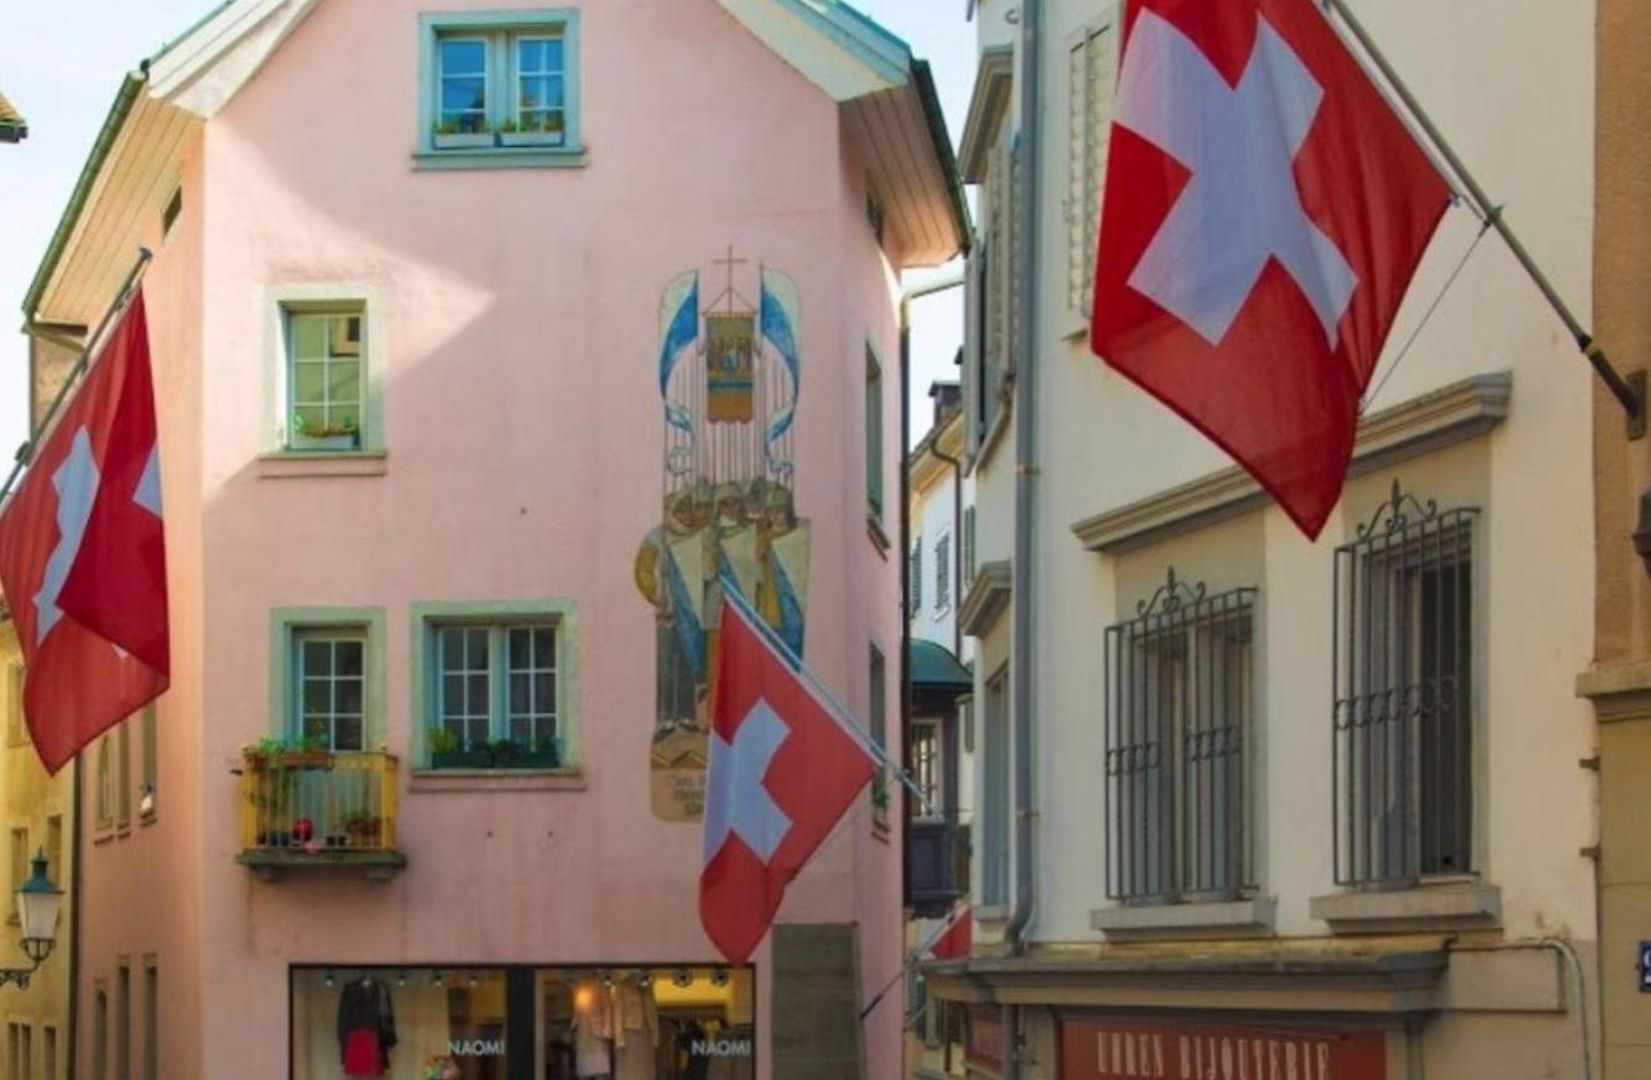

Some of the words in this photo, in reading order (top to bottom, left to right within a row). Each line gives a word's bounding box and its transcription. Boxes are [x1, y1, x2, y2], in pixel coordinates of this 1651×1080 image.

[447, 1039, 506, 1056] NAOMI
[691, 1039, 752, 1057] NAOMI
[1180, 1036, 1330, 1080] BIJOUTERIE
